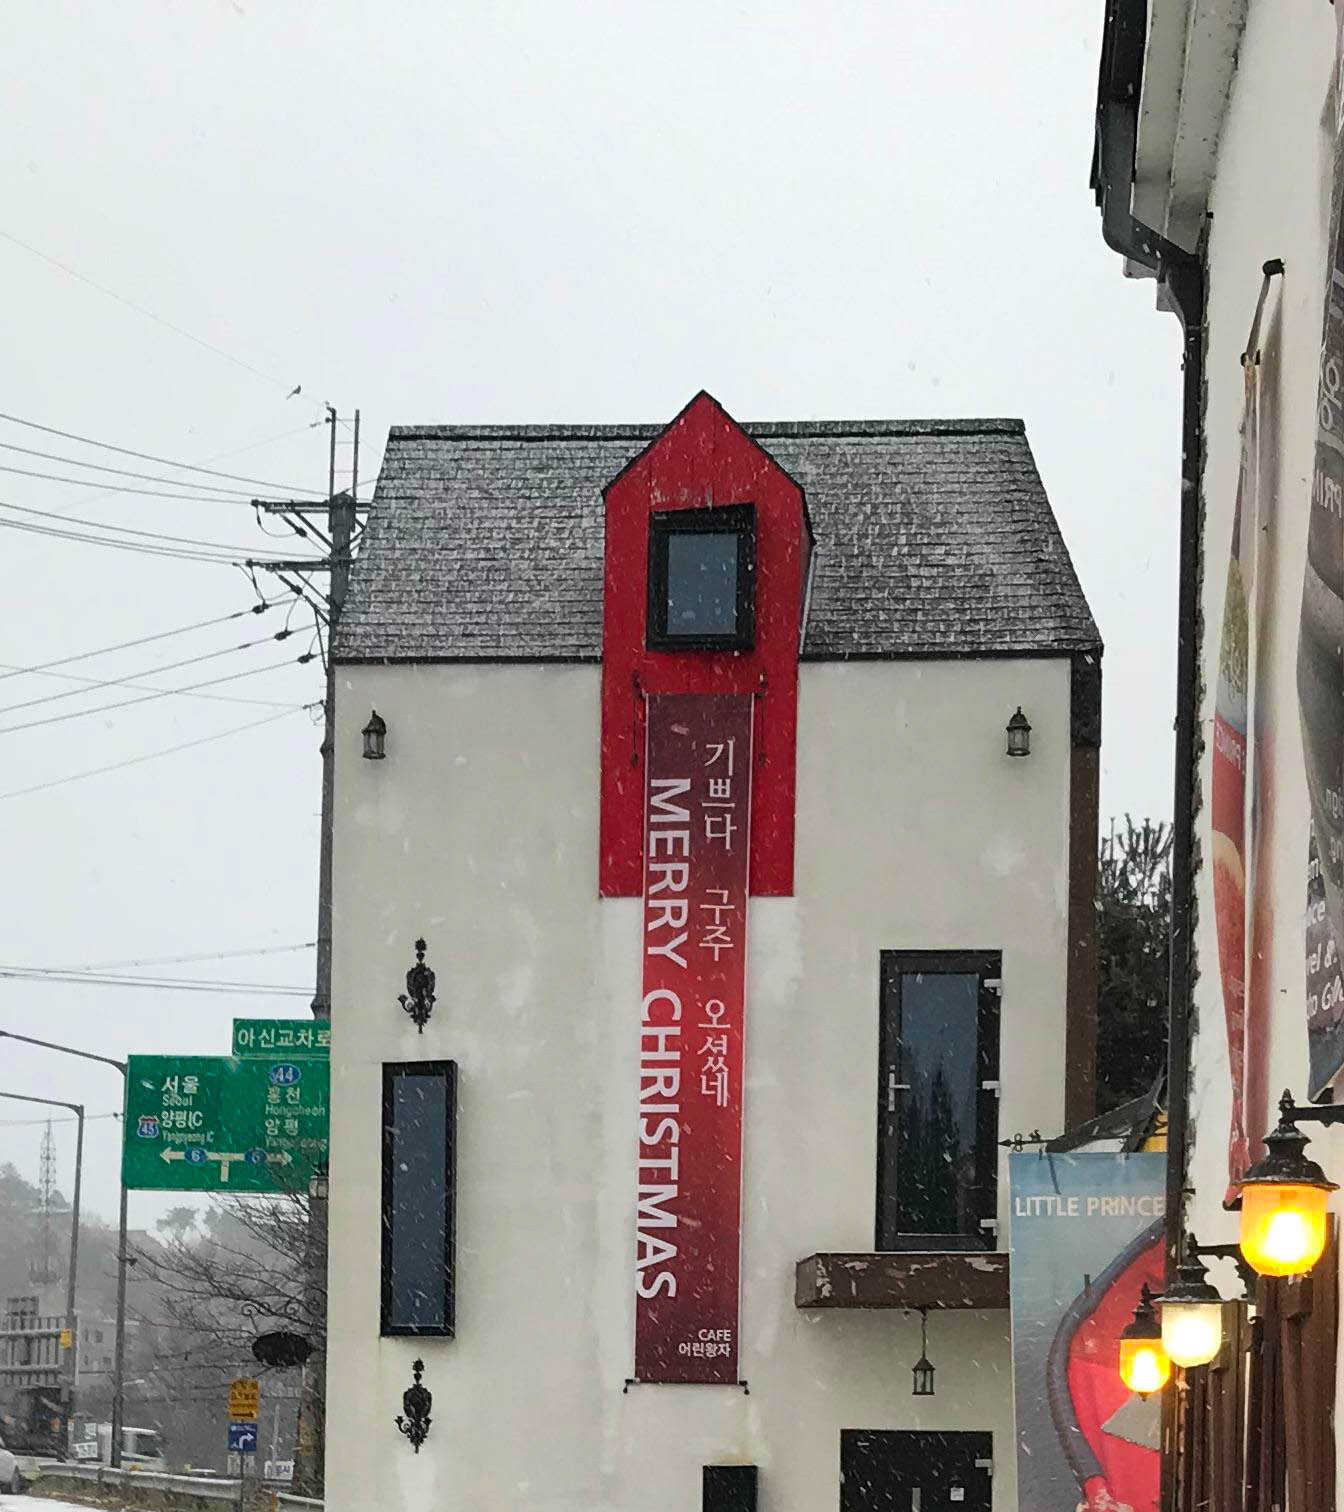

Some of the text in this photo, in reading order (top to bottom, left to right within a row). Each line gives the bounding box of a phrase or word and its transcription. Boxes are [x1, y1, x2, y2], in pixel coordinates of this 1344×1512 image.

[697, 736, 737, 1107] 기쁘다 구주 오셨네
[238, 1027, 331, 1048] 아신교차로
[636, 778, 691, 1300] MERRY CHRISTMAS
[276, 1067, 293, 1081] 44
[161, 1075, 199, 1094] 서울
[162, 1093, 192, 1106] Seoul
[265, 1118, 298, 1135] 양평
[191, 1150, 200, 1161] 6
[1015, 1195, 1167, 1217] LITTLE PRINCE
[698, 1329, 731, 1341] CAFE
[678, 1342, 731, 1358] 어린왕자
